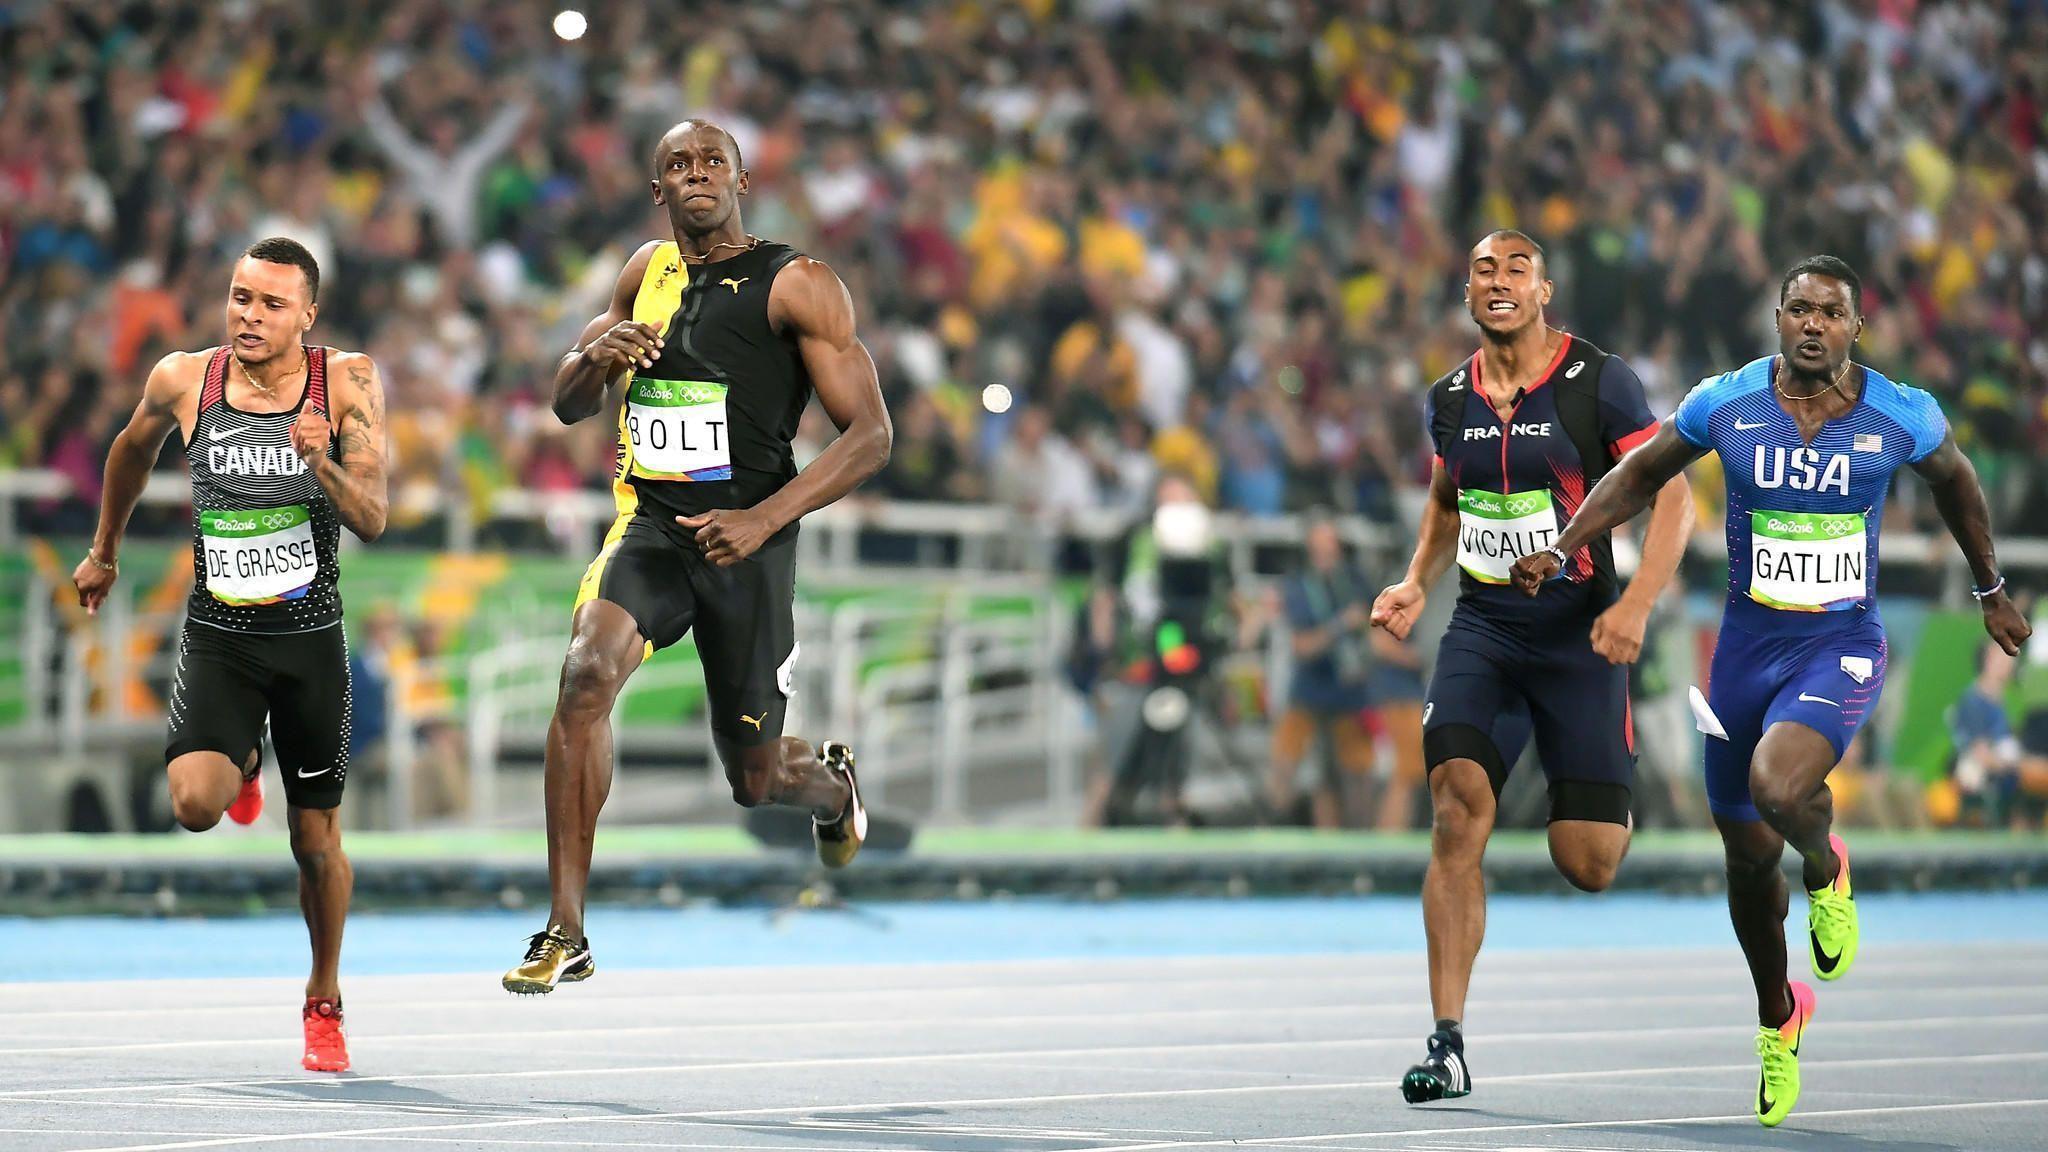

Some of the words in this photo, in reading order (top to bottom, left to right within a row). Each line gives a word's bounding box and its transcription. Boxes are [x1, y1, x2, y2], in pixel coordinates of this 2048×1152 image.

[629, 416, 724, 451] BOLT
[1463, 422, 1552, 441] FRANCE
[1753, 444, 1850, 496] USA
[214, 518, 257, 531] Rio2016
[1462, 524, 1554, 559] VICAUT
[1767, 518, 1814, 534] Rio2016
[208, 549, 231, 578] DE
[236, 539, 314, 578] GRASSE
[1756, 548, 1861, 584] GATLIN
